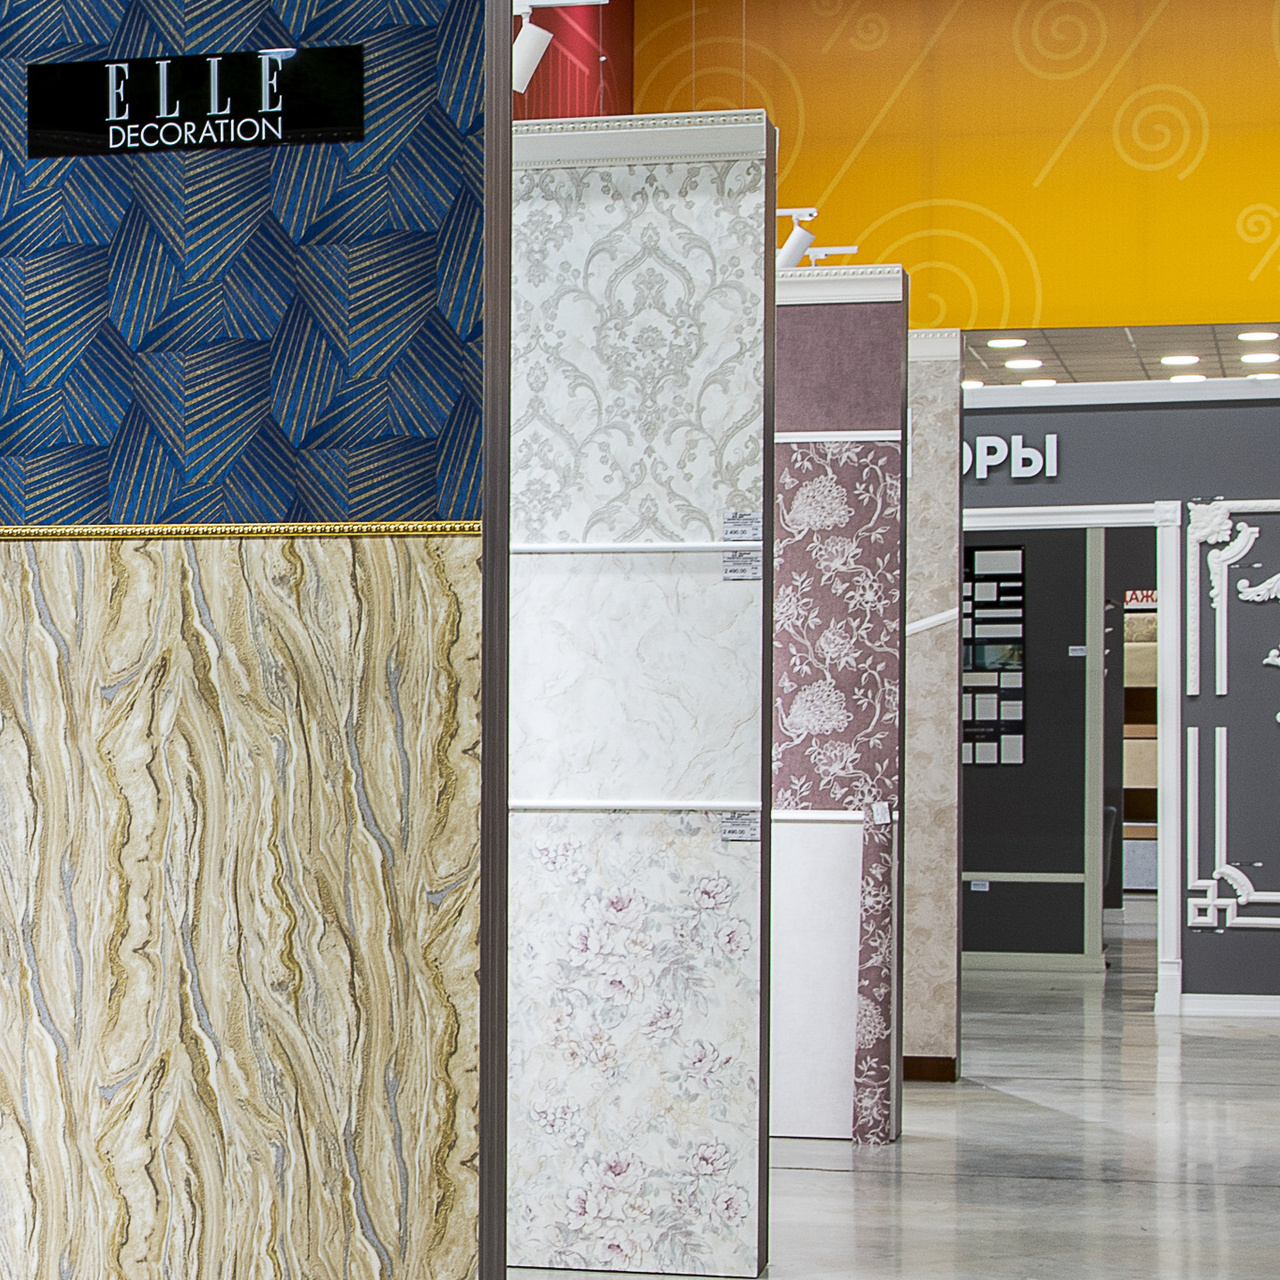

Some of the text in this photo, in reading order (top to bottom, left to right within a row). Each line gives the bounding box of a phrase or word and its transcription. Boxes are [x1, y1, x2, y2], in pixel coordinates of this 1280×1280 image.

[105, 54, 283, 122] ELLE
[109, 116, 283, 149] DECORATION
[1124, 589, 1158, 606] АЖ
